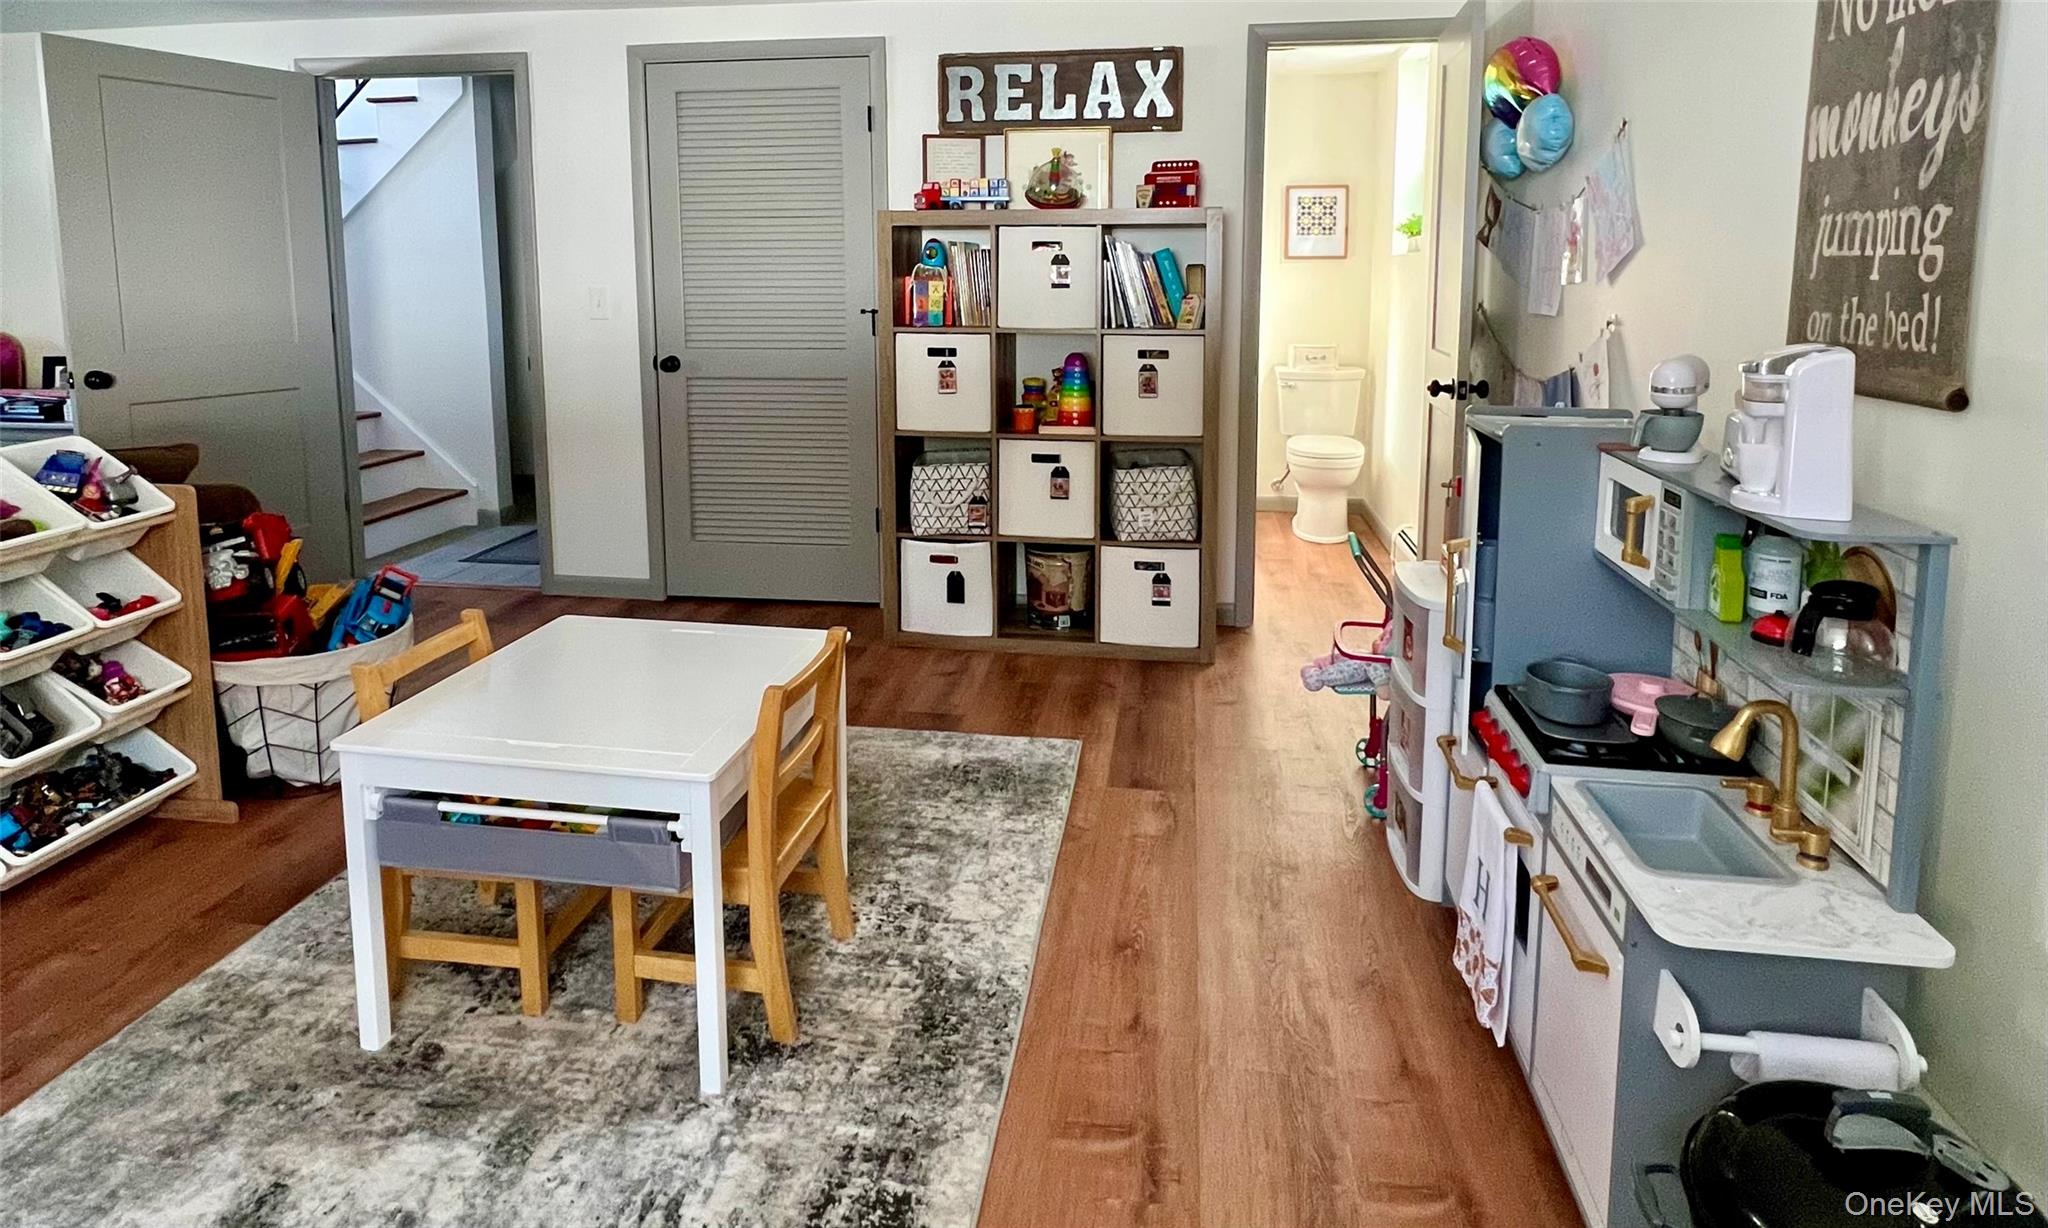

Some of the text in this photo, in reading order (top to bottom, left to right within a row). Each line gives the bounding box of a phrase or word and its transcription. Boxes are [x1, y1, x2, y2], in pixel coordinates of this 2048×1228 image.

[945, 59, 1174, 122] RELAX
[1808, 26, 1985, 190] monkeys
[1810, 188, 1953, 282] jumping
[1807, 292, 1942, 355] on the bed!
[1770, 592, 1788, 600] FDA
[1473, 855, 1491, 922] H
